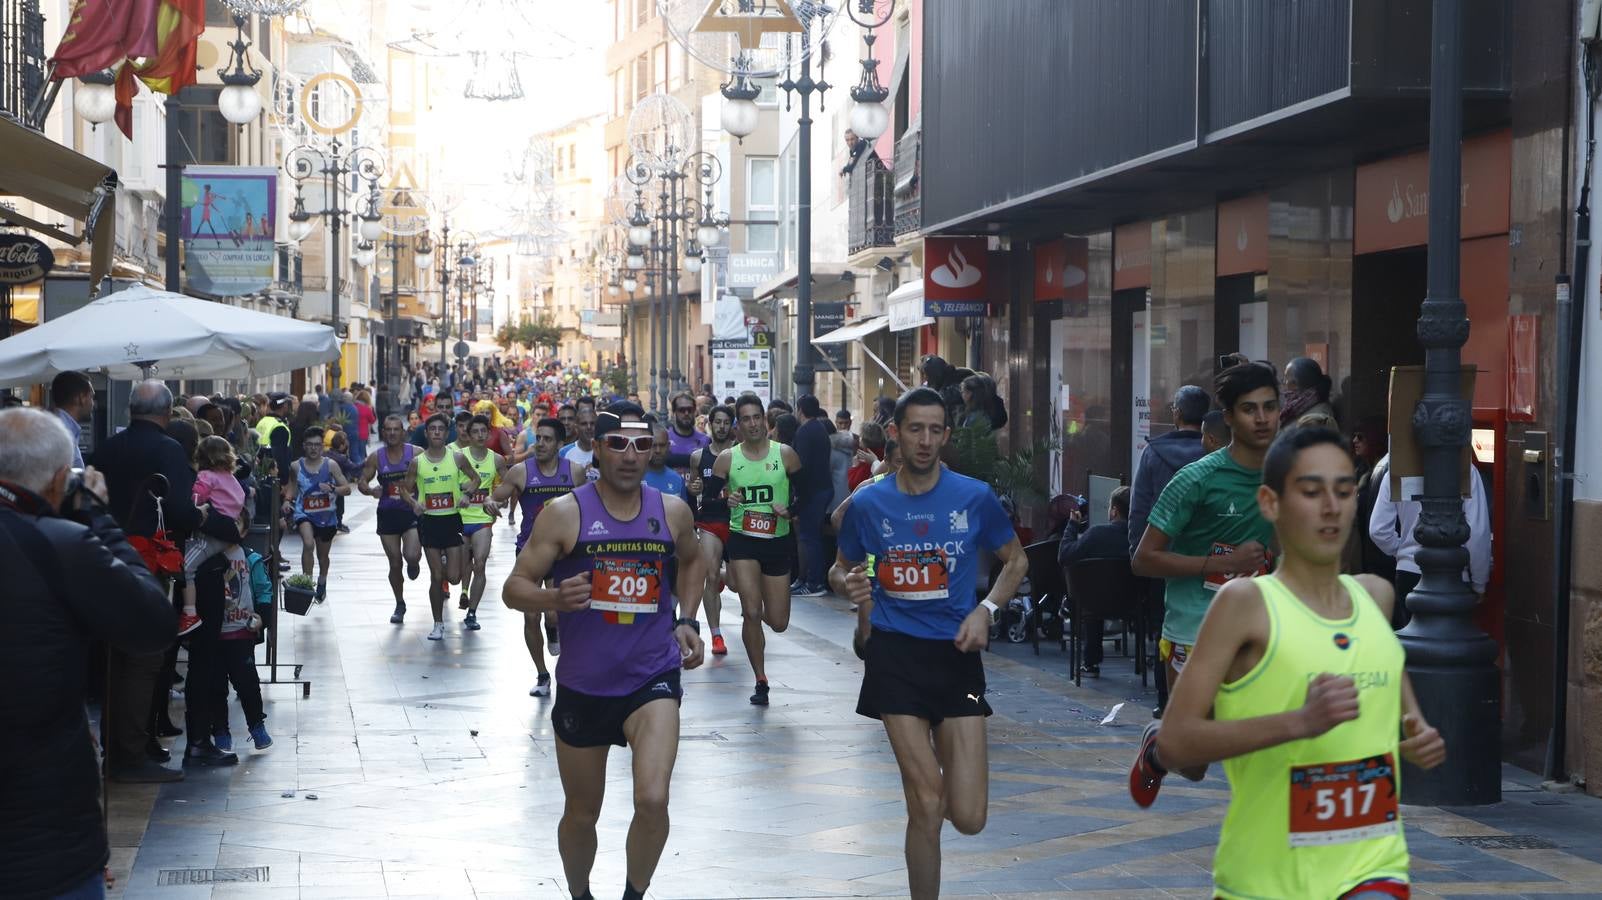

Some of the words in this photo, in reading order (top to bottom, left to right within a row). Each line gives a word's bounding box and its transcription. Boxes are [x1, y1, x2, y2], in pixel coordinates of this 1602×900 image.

[943, 303, 985, 313] TELEBANCO
[431, 497, 449, 508] 514
[750, 518, 770, 531] 500
[607, 542, 642, 553] PUERTAS
[643, 542, 666, 554] LORCA
[893, 566, 929, 585] 501
[607, 575, 648, 597] 209
[1316, 783, 1376, 820] 517
